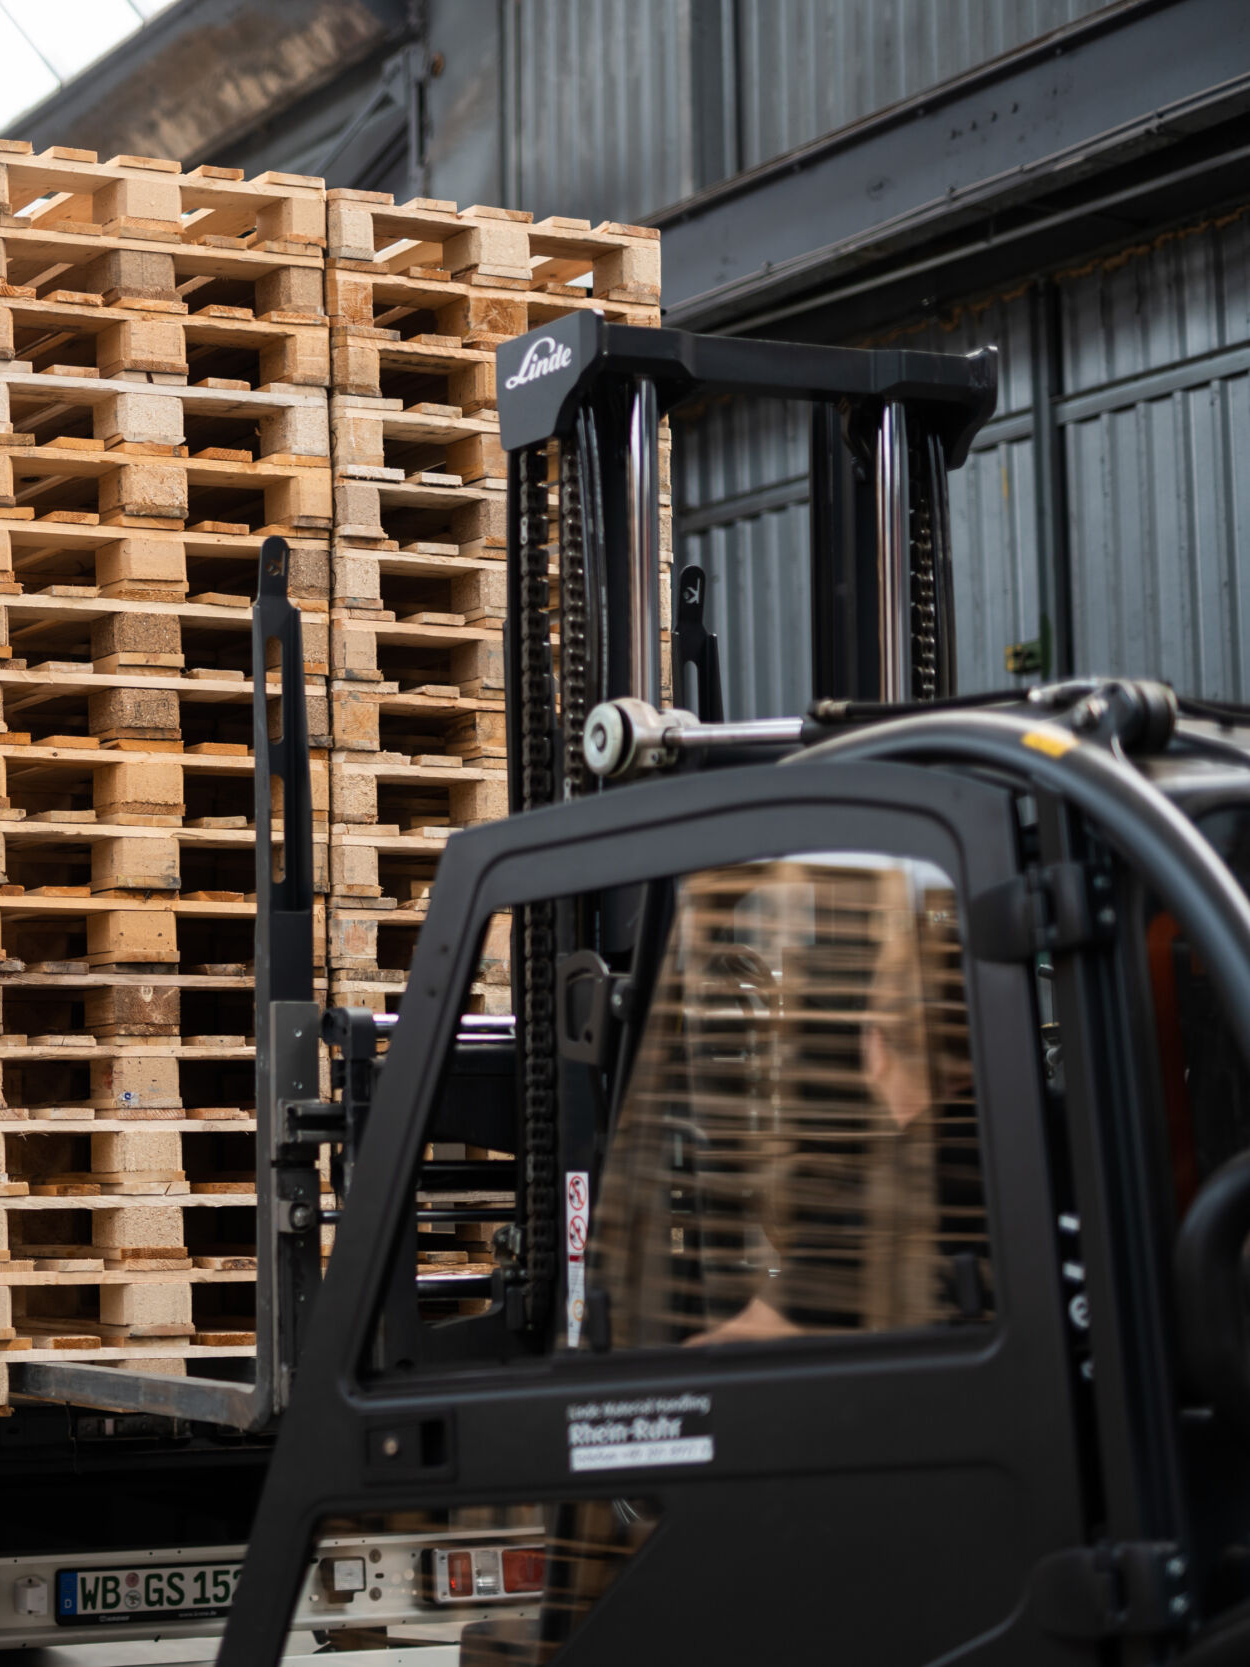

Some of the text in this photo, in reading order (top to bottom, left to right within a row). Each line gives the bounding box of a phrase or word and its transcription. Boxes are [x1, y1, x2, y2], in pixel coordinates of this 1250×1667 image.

[505, 336, 572, 390] Linde
[568, 1416, 683, 1445] Rhein-Ruhr
[64, 1599, 72, 1609] D
[80, 1574, 121, 1610] WB
[144, 1572, 185, 1607] GS
